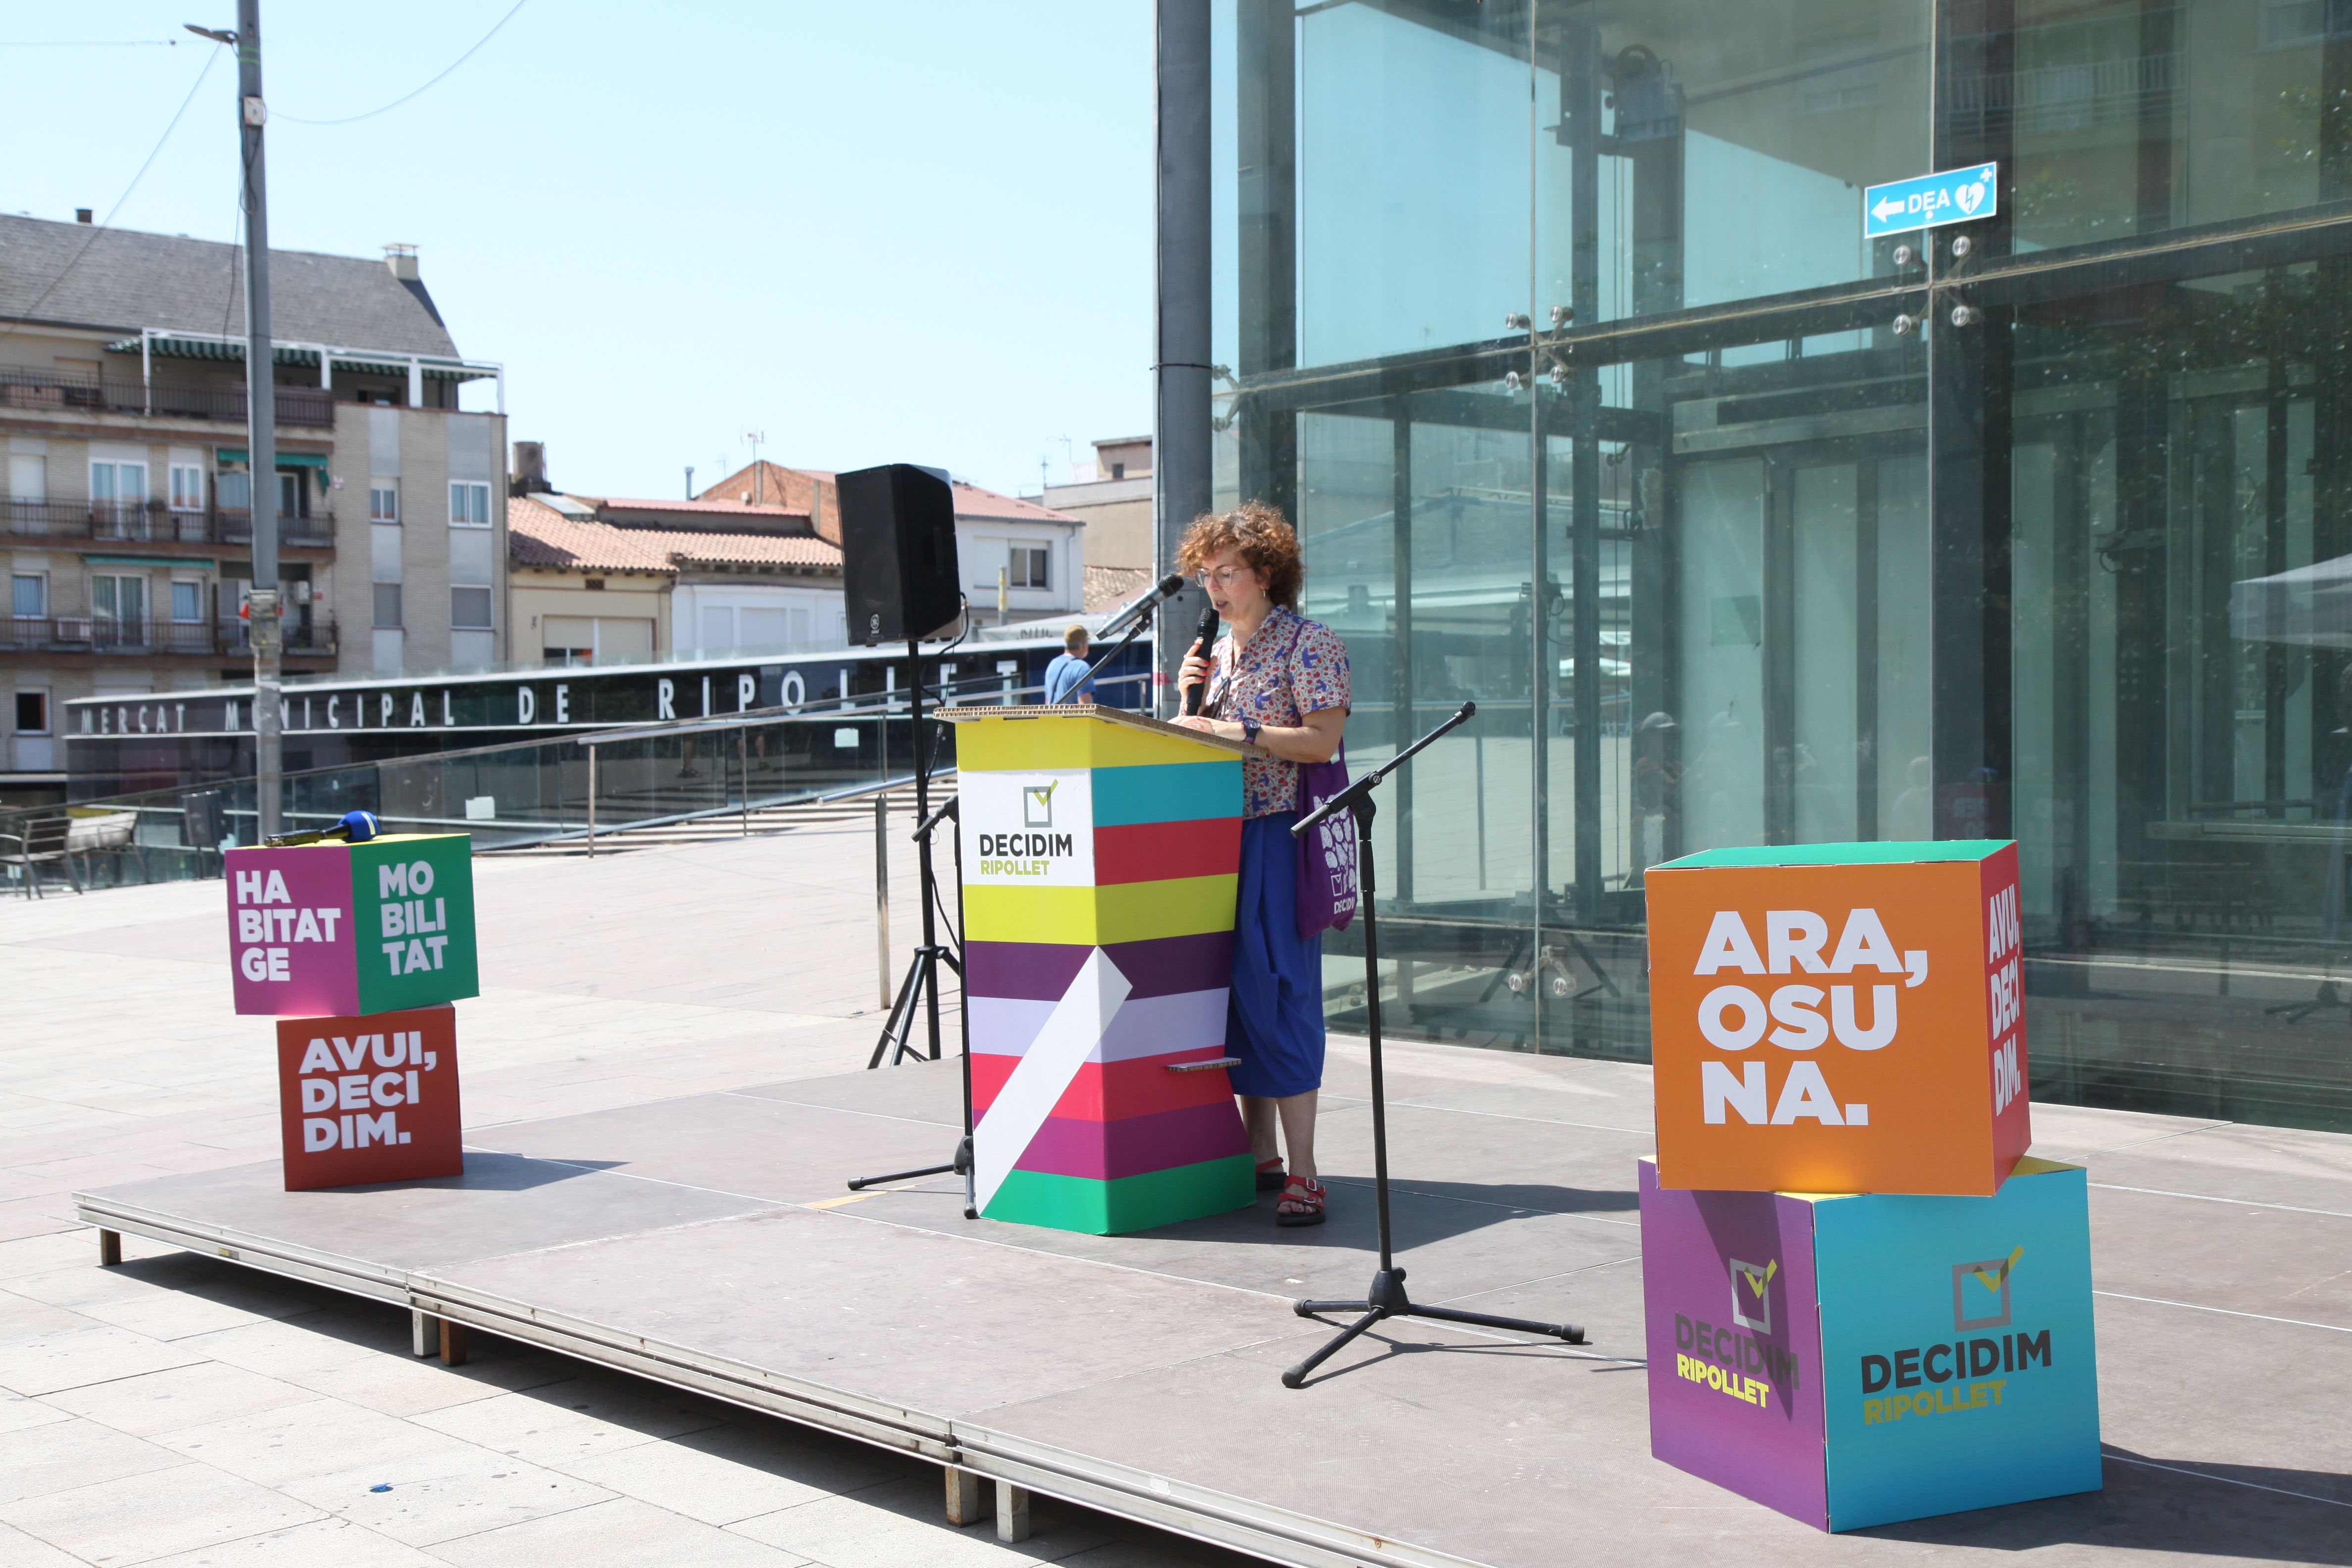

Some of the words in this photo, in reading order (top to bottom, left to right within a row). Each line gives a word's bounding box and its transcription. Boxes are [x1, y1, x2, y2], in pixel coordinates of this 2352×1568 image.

[1908, 188, 1951, 214] DEA
[81, 703, 186, 735] MERCAT
[518, 684, 569, 725] DE
[980, 833, 1073, 857] DECIDIM
[236, 870, 292, 904] HA
[379, 860, 434, 899] MO
[980, 860, 1050, 875] RIPOLLET
[238, 908, 341, 943] BITAT
[380, 897, 445, 938] BILI
[1989, 883, 2020, 964] AVUI,
[241, 947, 291, 981] GE
[382, 935, 448, 976] TAT
[1693, 908, 1928, 988] ARA,
[1698, 984, 1898, 1051] OSU
[1991, 956, 2020, 1040] DECI
[298, 1031, 437, 1074] AVUI,
[301, 1070, 420, 1113] DECI
[1701, 1061, 1869, 1126] NA.
[1994, 1033, 2021, 1117] DIM.
[303, 1111, 411, 1152] DIM.
[1675, 1313, 1800, 1391] DECIDIM
[1861, 1329, 2052, 1395] DECIDIM
[1676, 1353, 1769, 1408] RIPOLLET
[1863, 1379, 2007, 1425] RIPOLLET
